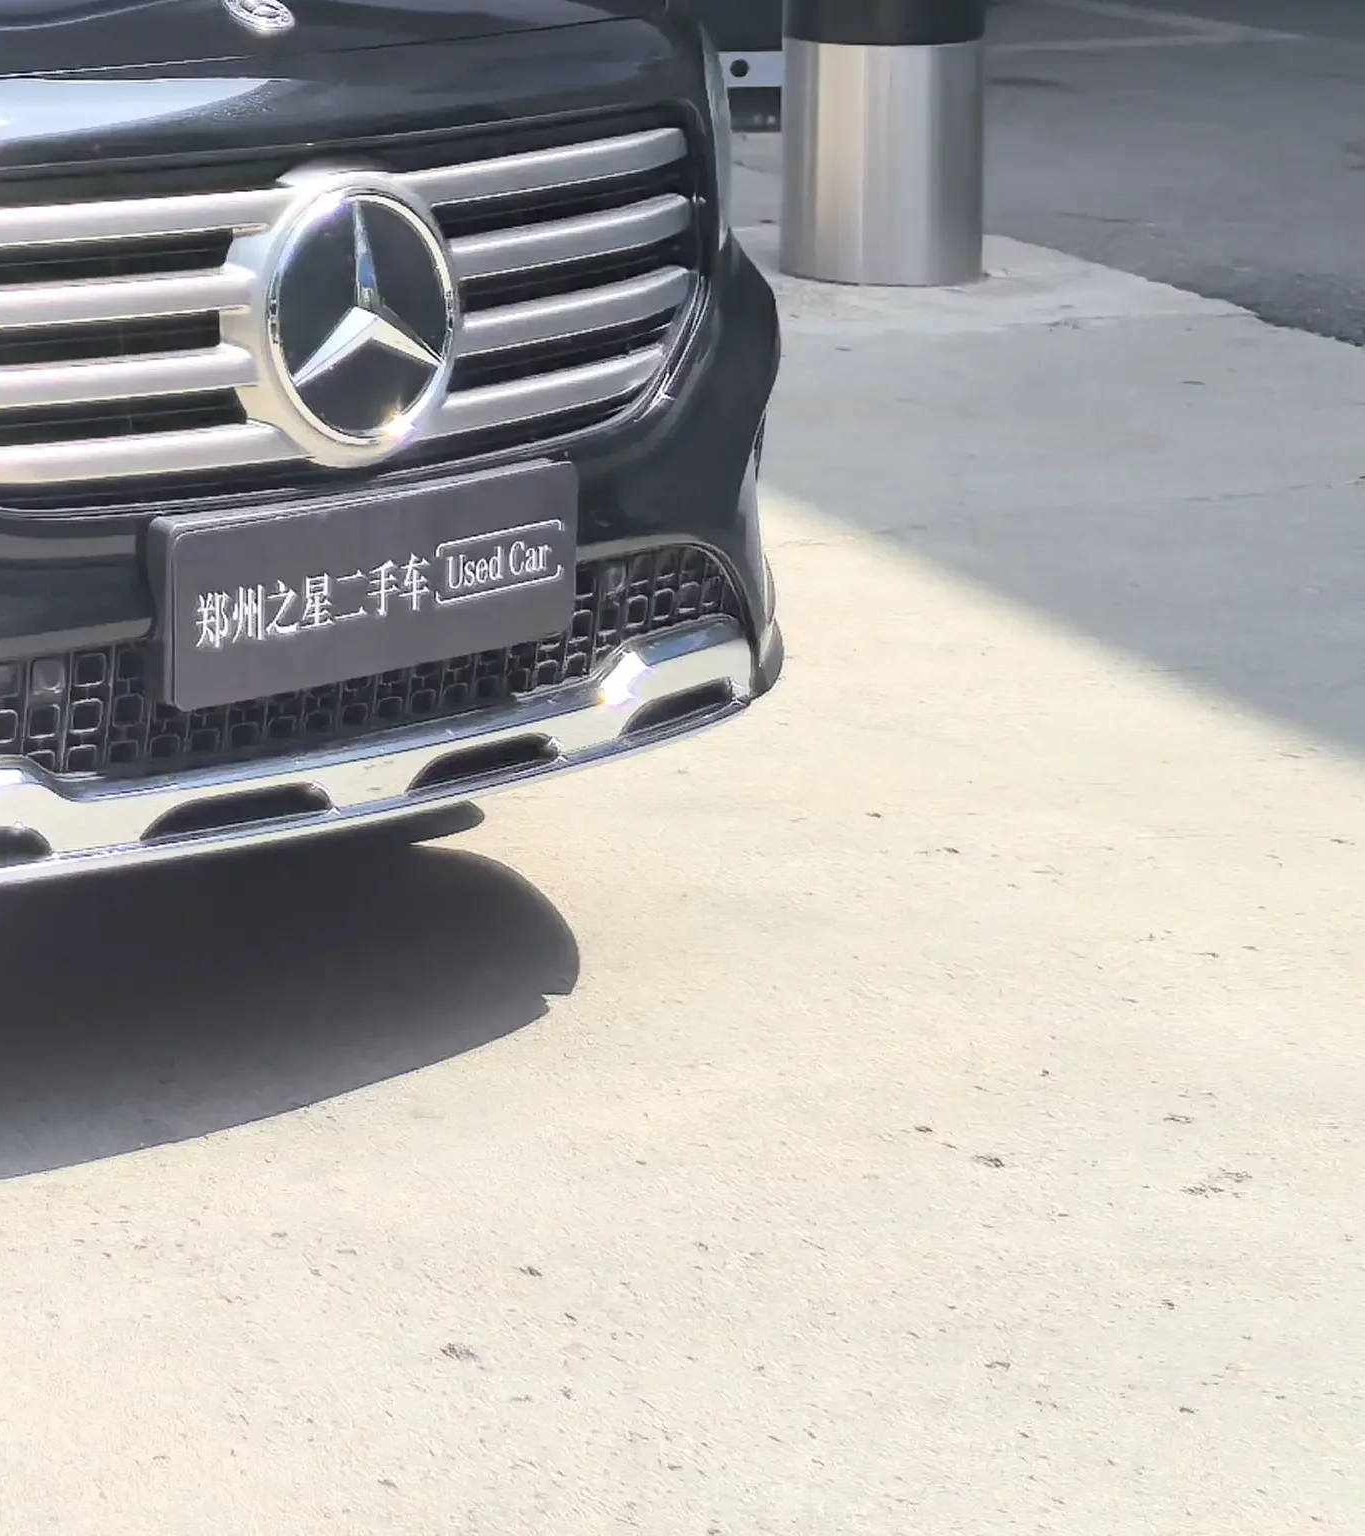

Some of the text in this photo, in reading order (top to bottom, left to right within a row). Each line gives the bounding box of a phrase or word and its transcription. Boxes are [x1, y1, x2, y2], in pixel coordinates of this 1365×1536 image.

[195, 540, 553, 650] 郑州之星二手车 Used Car
